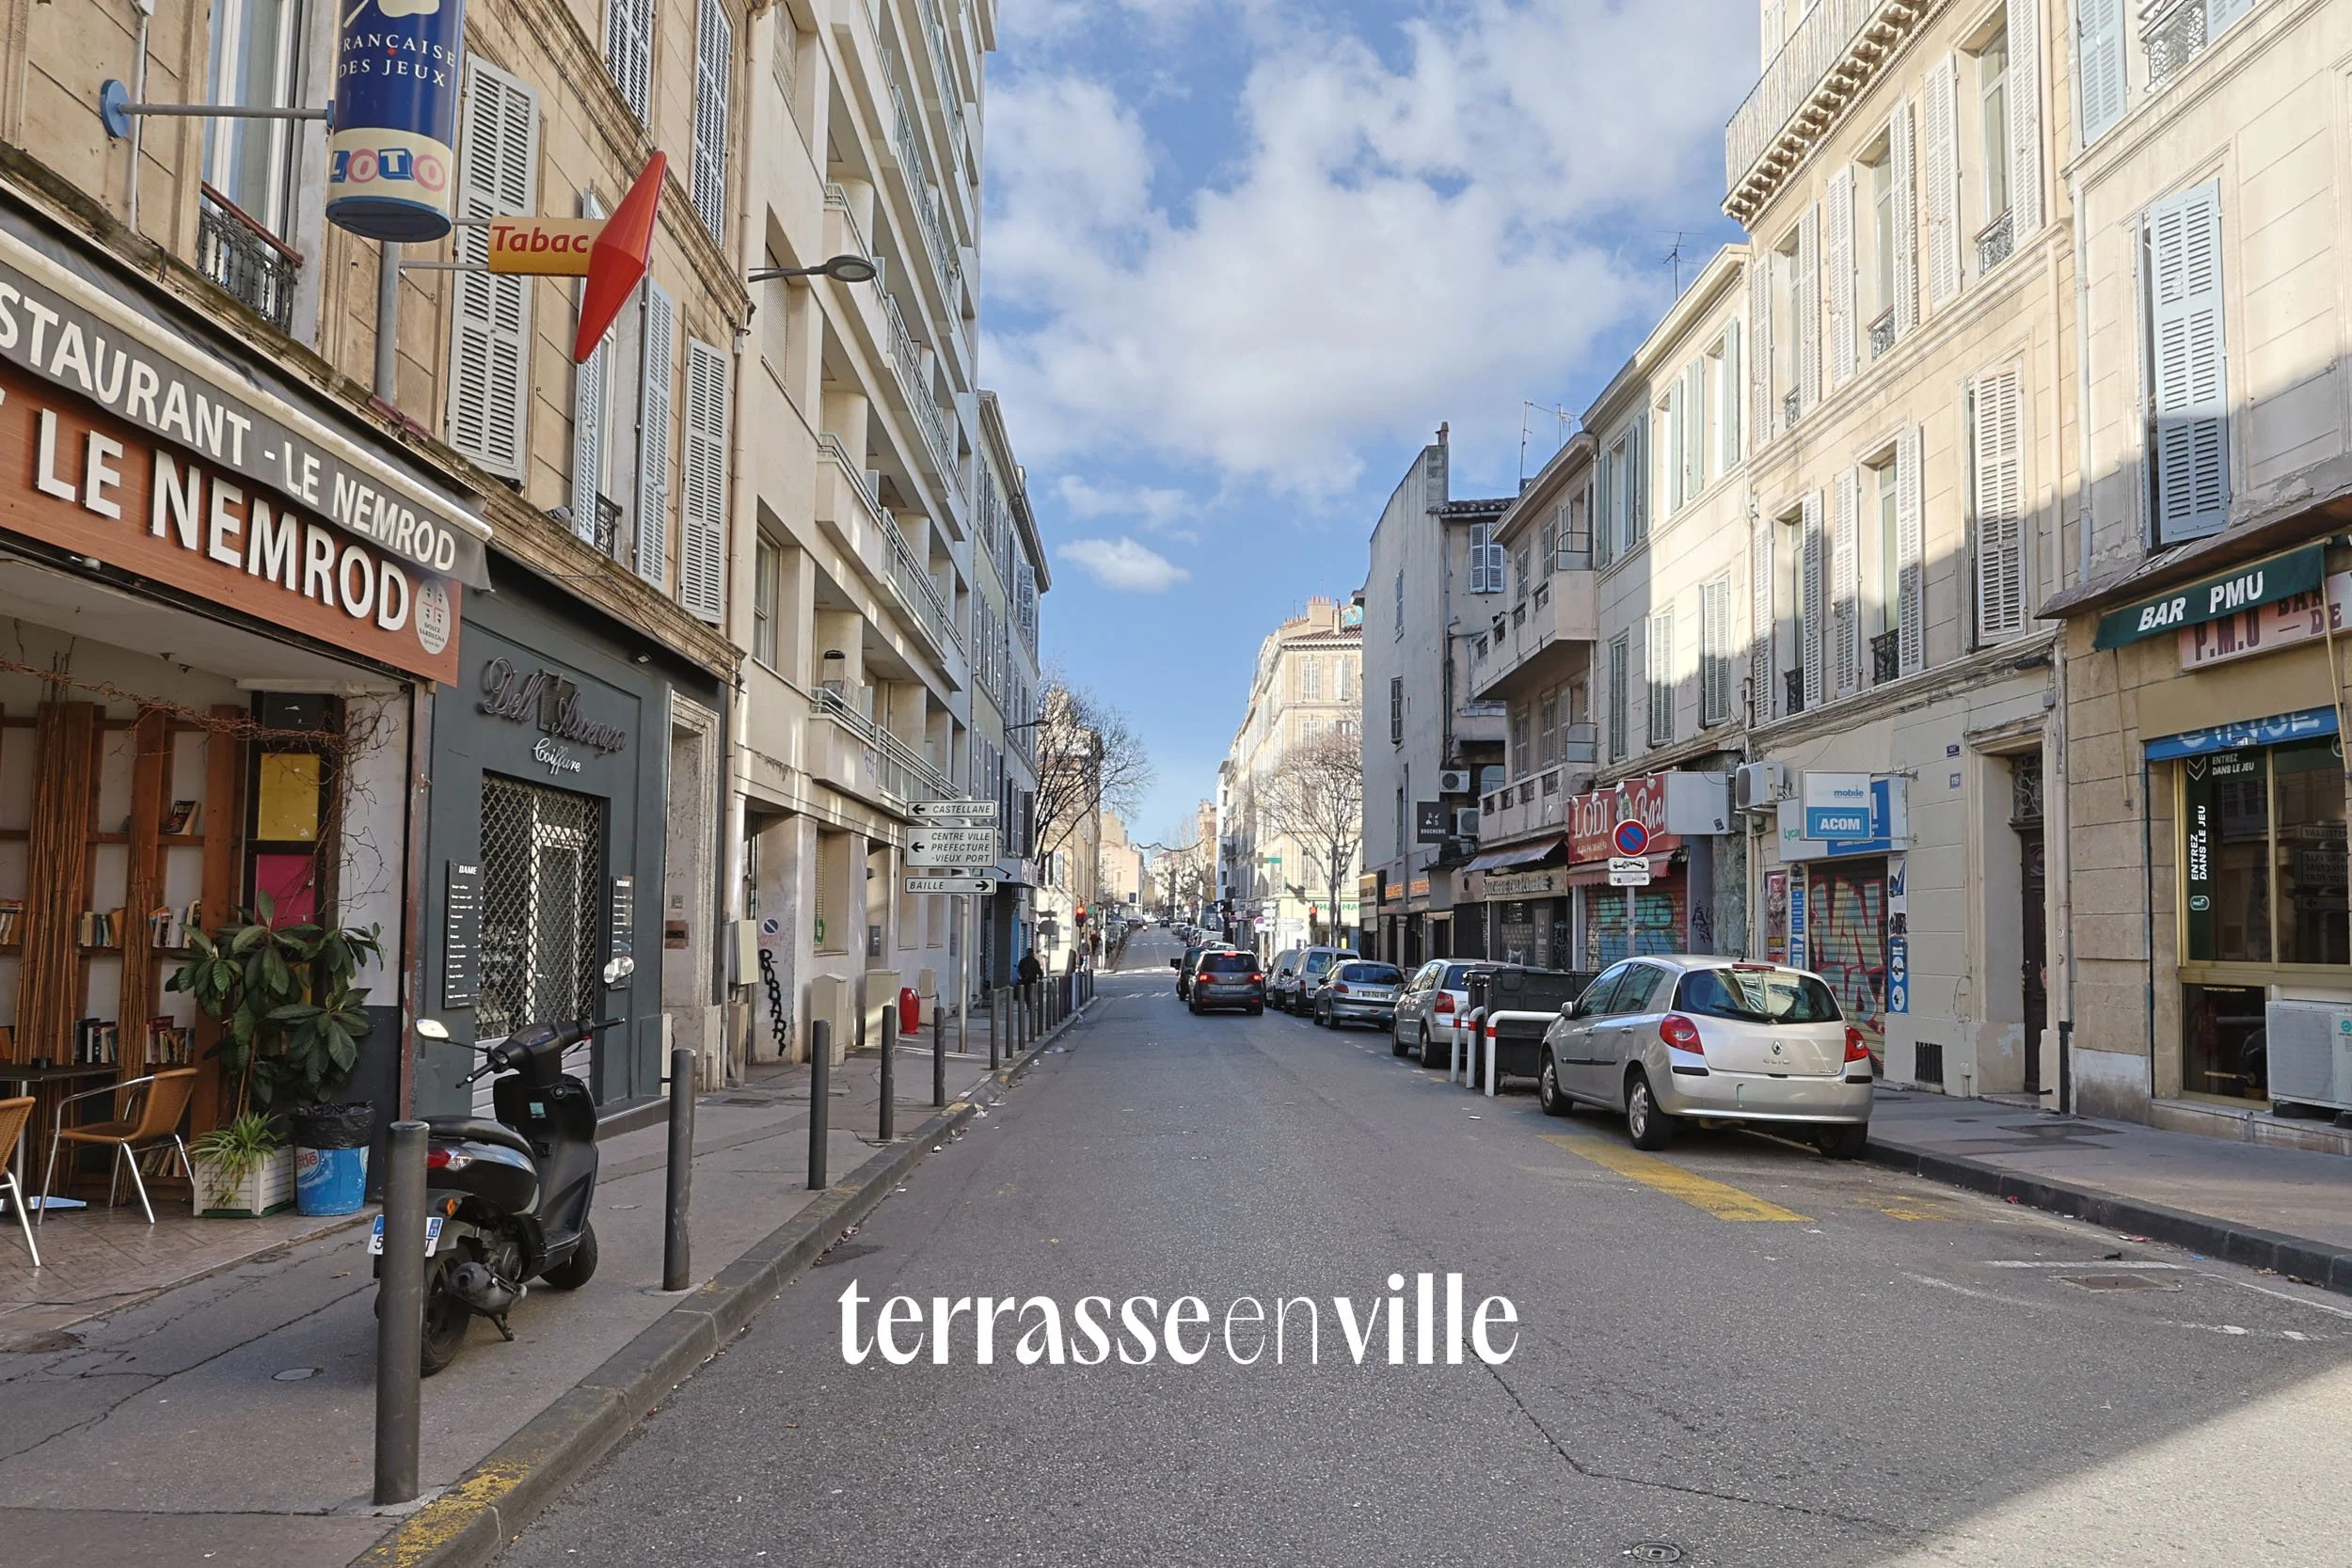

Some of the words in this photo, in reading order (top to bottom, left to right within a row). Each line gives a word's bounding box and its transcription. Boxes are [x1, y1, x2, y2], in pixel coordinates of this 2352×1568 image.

[342, 33, 455, 68] RANÇAISE
[339, 58, 371, 79] DES
[382, 59, 445, 87] JEUX
[331, 149, 446, 191] LOTO
[492, 226, 589, 254] Tabac
[0, 285, 251, 467] STAURANT
[285, 440, 320, 506] LE
[333, 472, 456, 572] NEMROD
[37, 407, 124, 521] LE
[151, 449, 410, 632] NEMROD
[2137, 596, 2186, 632] BAR
[2209, 571, 2264, 614] PMU
[532, 737, 581, 775] Coiffure
[2212, 753, 2238, 765] ENTREZ
[2212, 765, 2232, 776] DANS
[2233, 763, 2241, 772] LE
[2241, 762, 2255, 771] JEU
[1834, 784, 1865, 798] mobile
[932, 805, 991, 814] CASTELLANE
[1573, 798, 1609, 839] LODI
[2198, 805, 2206, 828] JEU
[1820, 817, 1860, 831] ACOM
[931, 832, 964, 841] CENTRE
[968, 832, 991, 841] VILLE
[2198, 829, 2207, 844] LE
[930, 843, 991, 852] PREFECTURE
[2190, 834, 2200, 880] ENTREZ
[965, 854, 991, 863] PORT
[2198, 847, 2208, 880] DANS
[458, 864, 478, 875] DAME
[910, 881, 945, 890] BAILLE
[295, 1150, 318, 1169] stlé
[429, 1227, 438, 1236] 13
